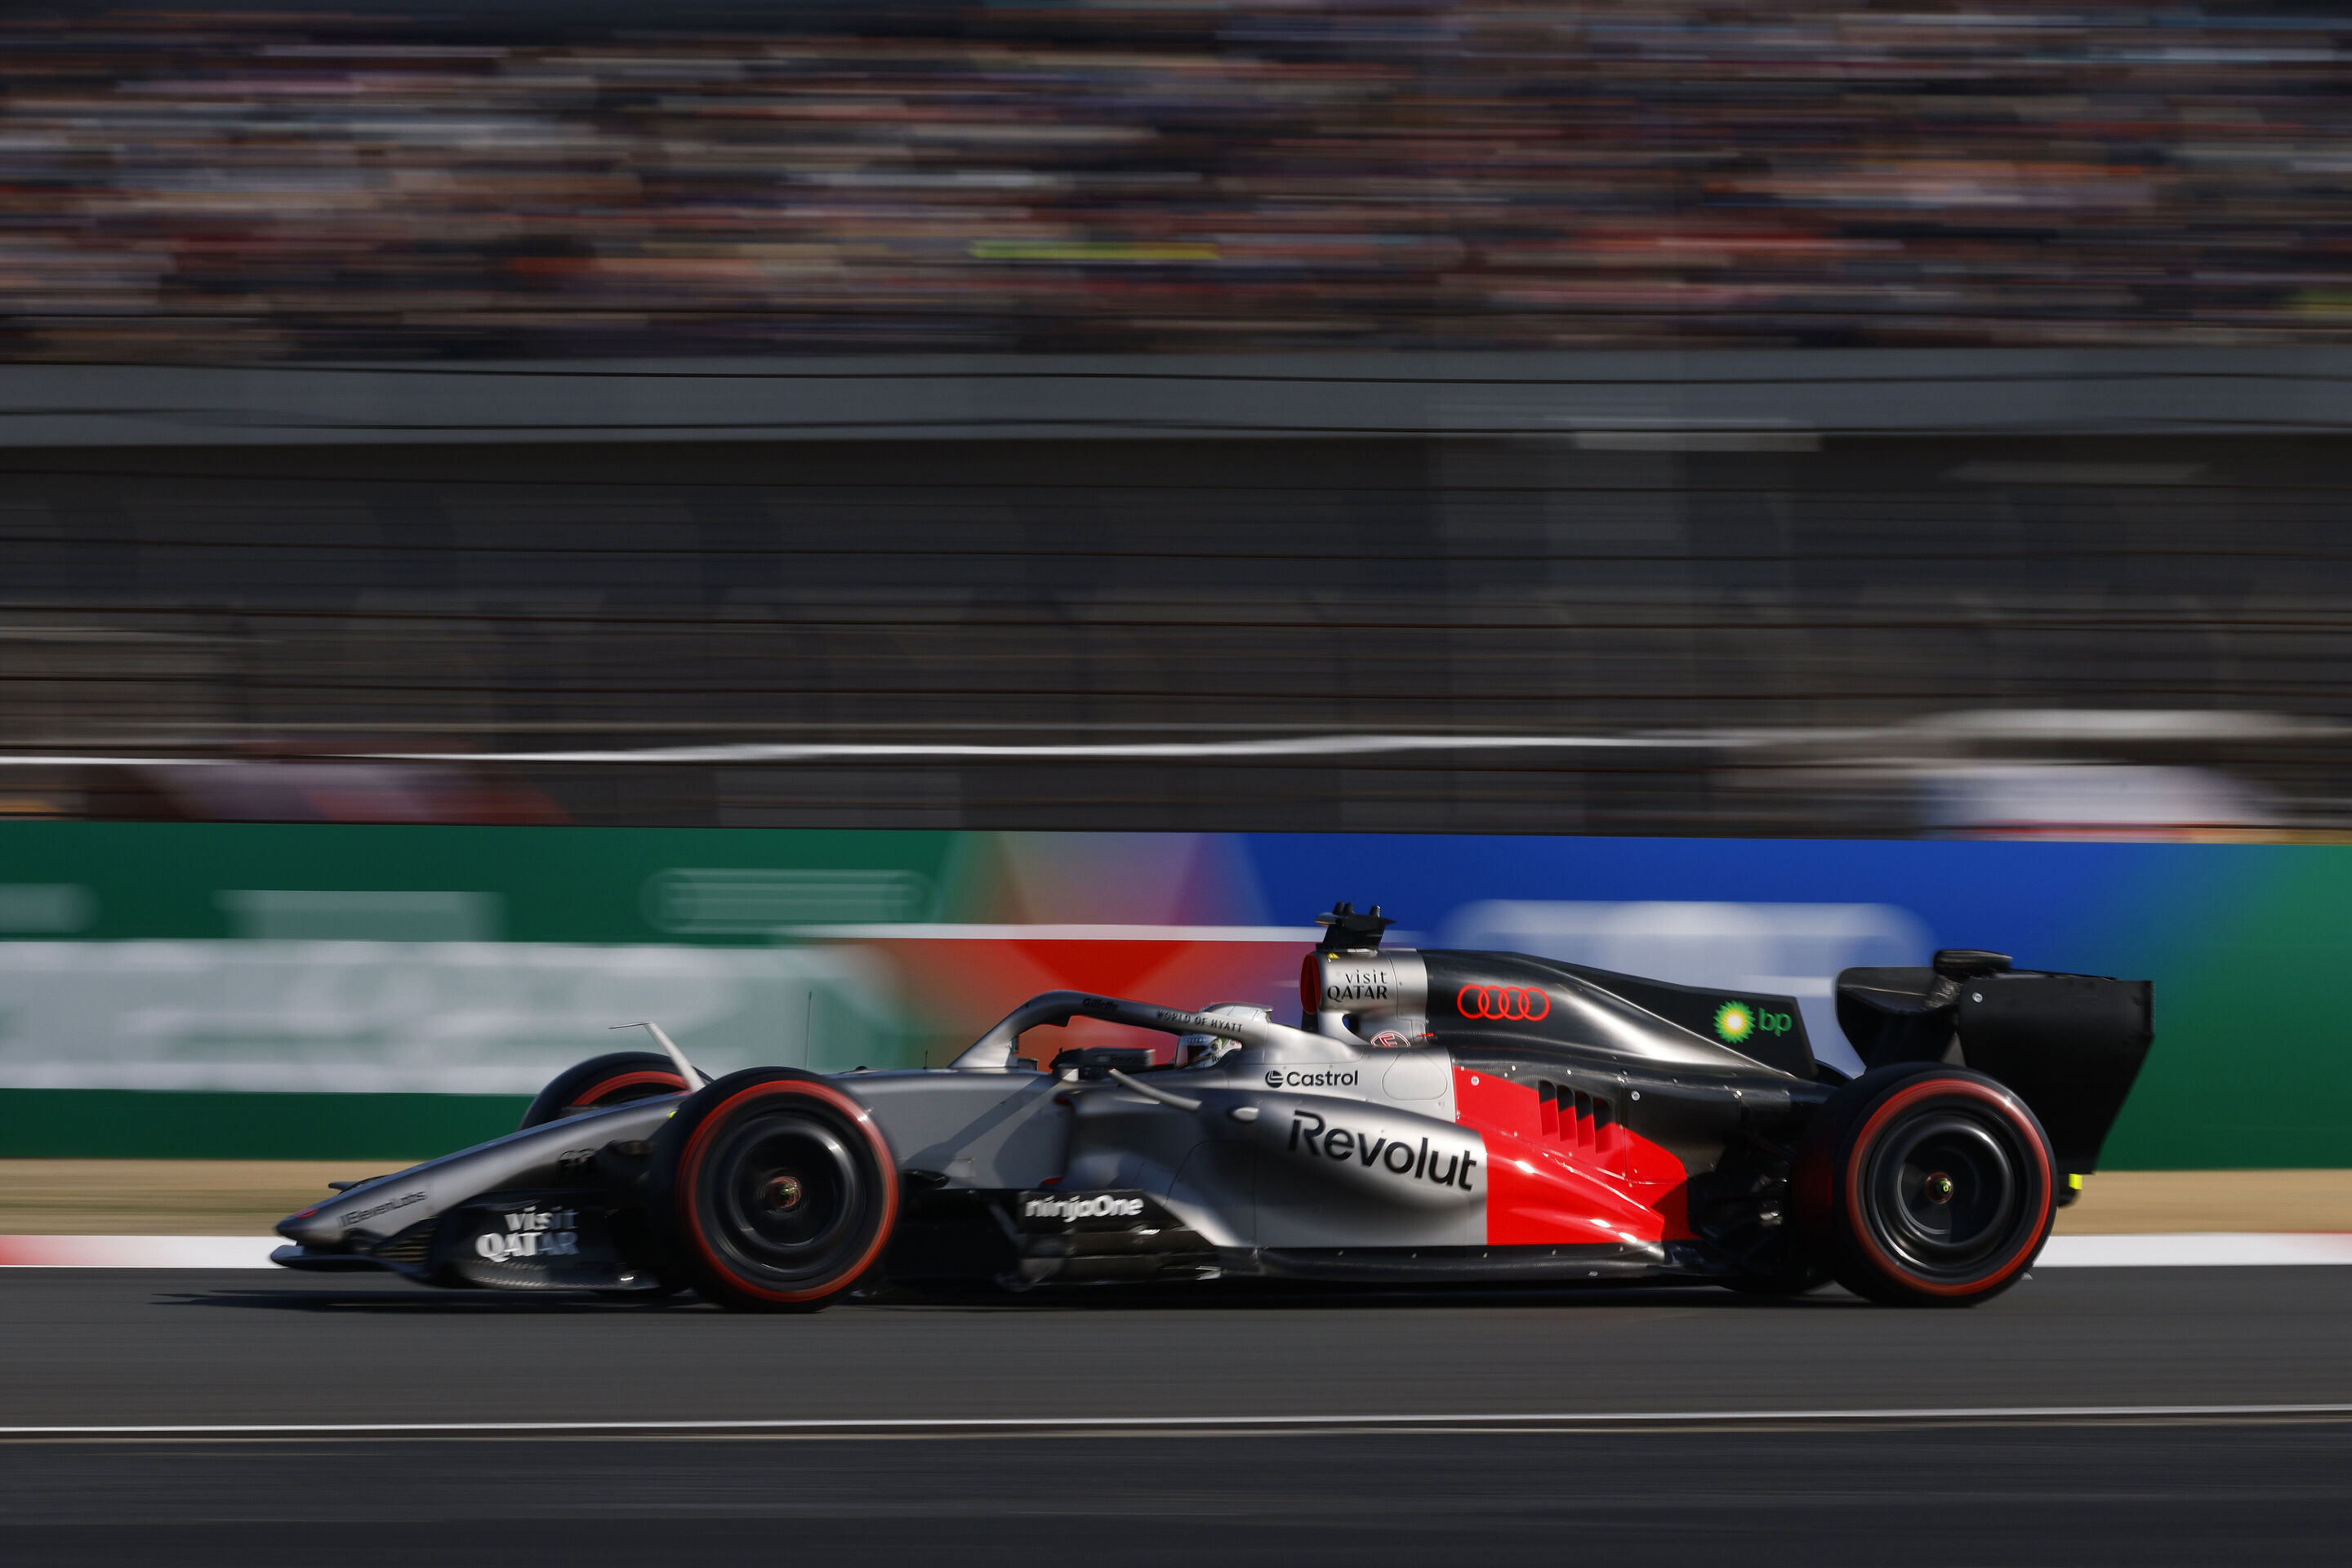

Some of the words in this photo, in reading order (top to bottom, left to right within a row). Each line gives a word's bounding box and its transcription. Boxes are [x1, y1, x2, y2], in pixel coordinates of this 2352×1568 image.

[1344, 969, 1388, 985] visit
[1327, 985, 1388, 1003] QATAR
[1157, 1009, 1191, 1024] WORLD
[1195, 1016, 1208, 1026] OF
[1210, 1019, 1242, 1032] HYATT
[1758, 1007, 1793, 1037] bp
[1286, 1070, 1358, 1087] Castrol
[1287, 1109, 1477, 1192] Revolut
[504, 1205, 579, 1232] visit
[475, 1232, 579, 1263] QATAR
